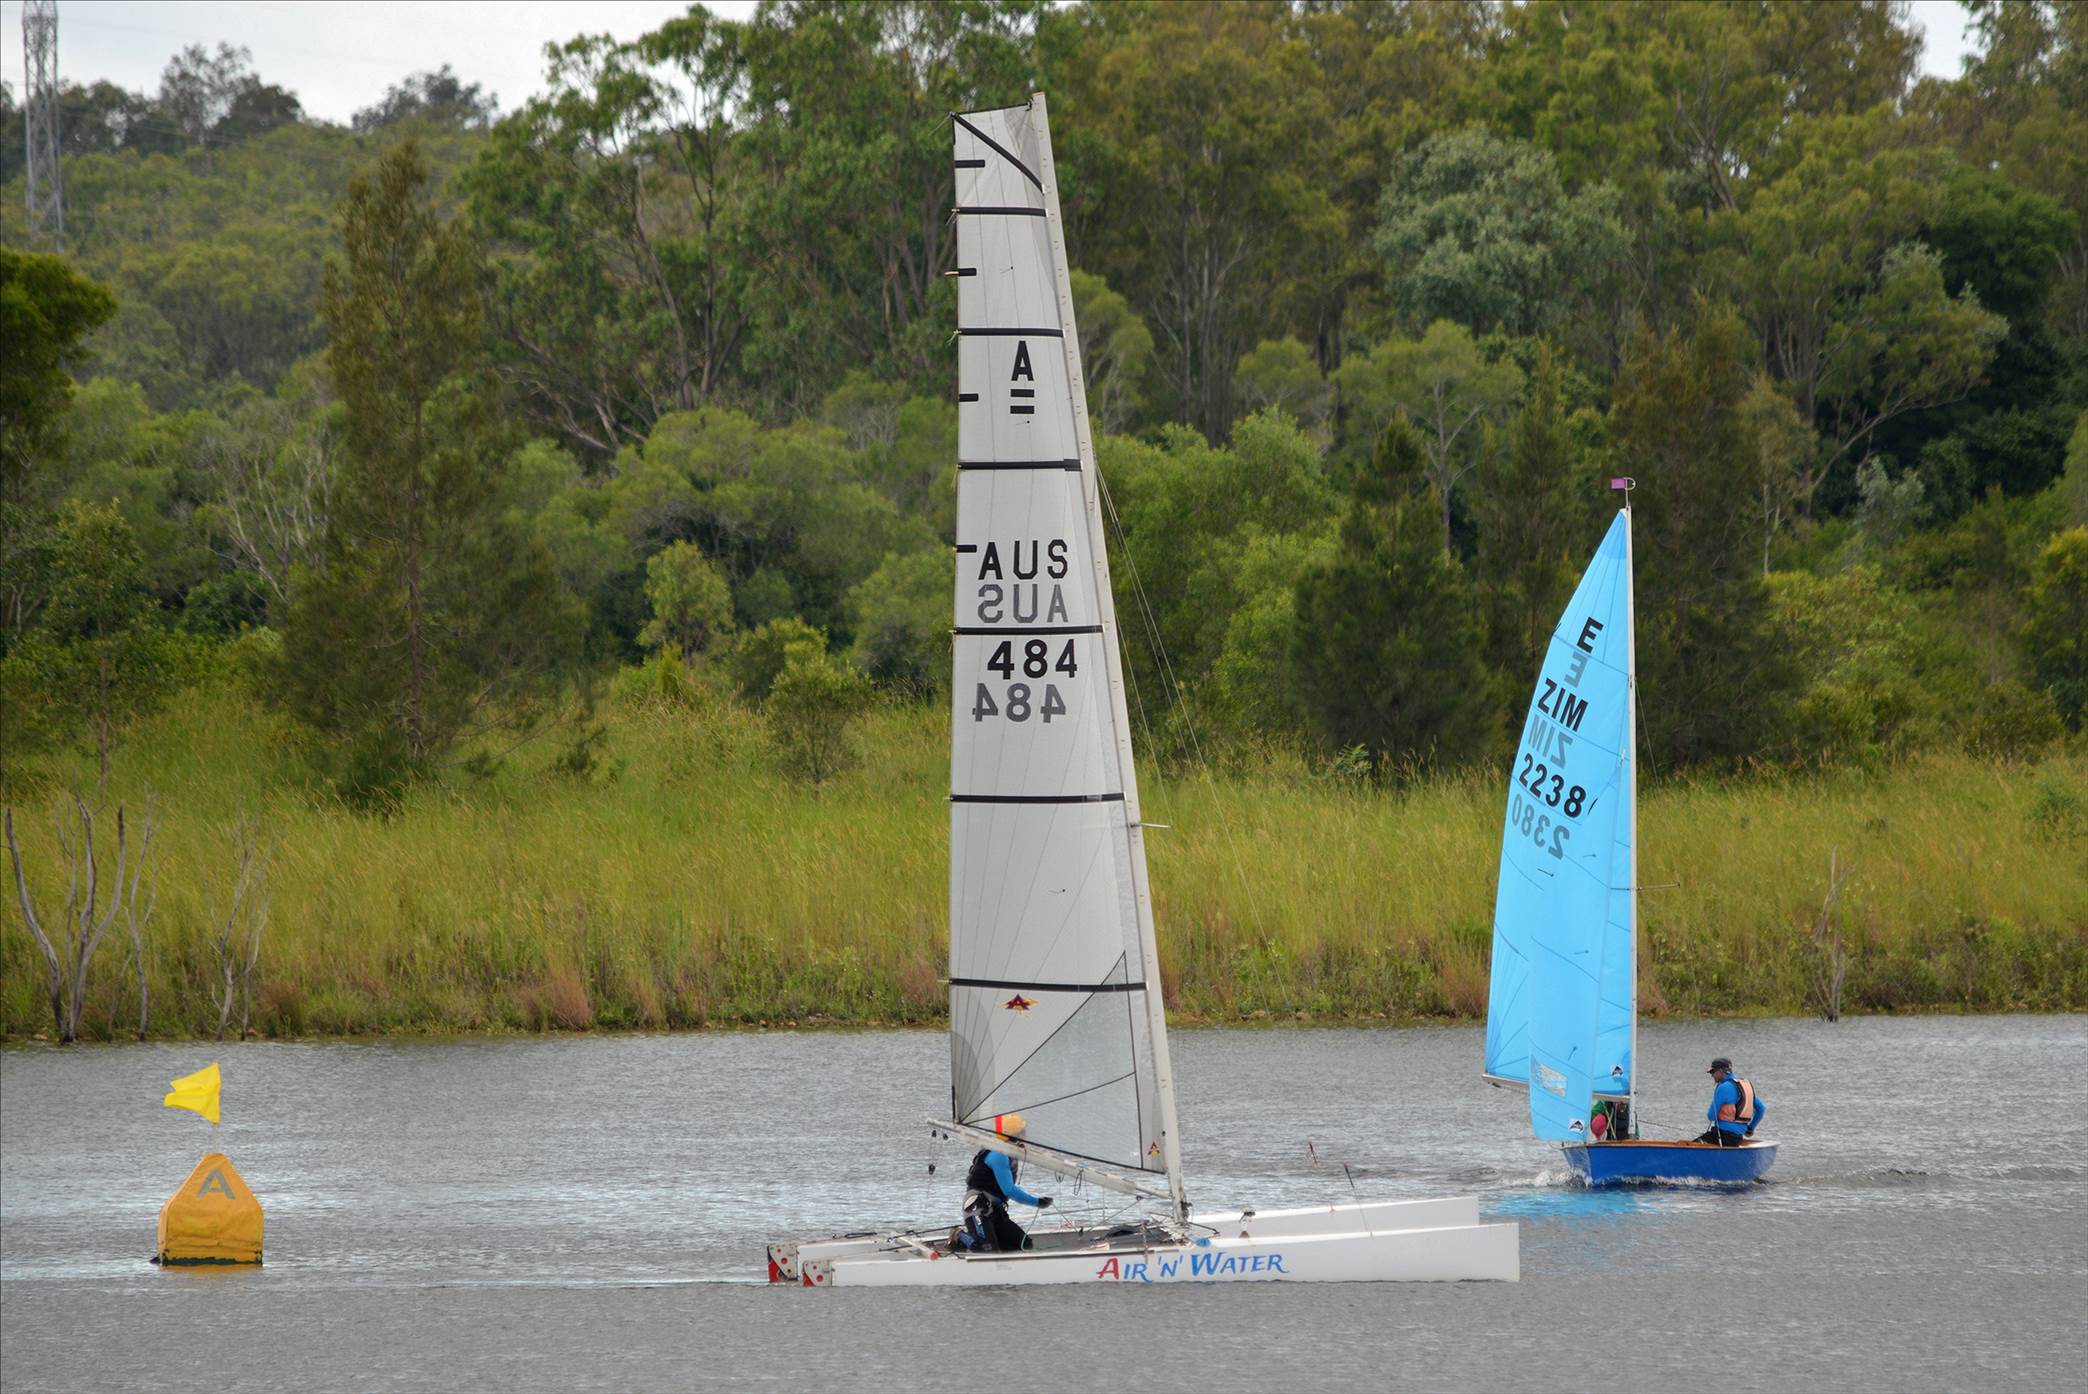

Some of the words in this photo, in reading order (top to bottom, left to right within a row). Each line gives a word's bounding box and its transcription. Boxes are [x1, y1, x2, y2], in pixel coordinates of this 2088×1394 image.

[1011, 340, 1034, 381] A
[978, 539, 1068, 580] AUS
[1577, 616, 1604, 654] E
[987, 639, 1077, 680] 484
[1537, 677, 1588, 732] ZIM
[1518, 753, 1587, 818] 2238
[196, 1167, 236, 1200] A
[1096, 1256, 1153, 1283] AIR
[1191, 1252, 1290, 1276] WATER
